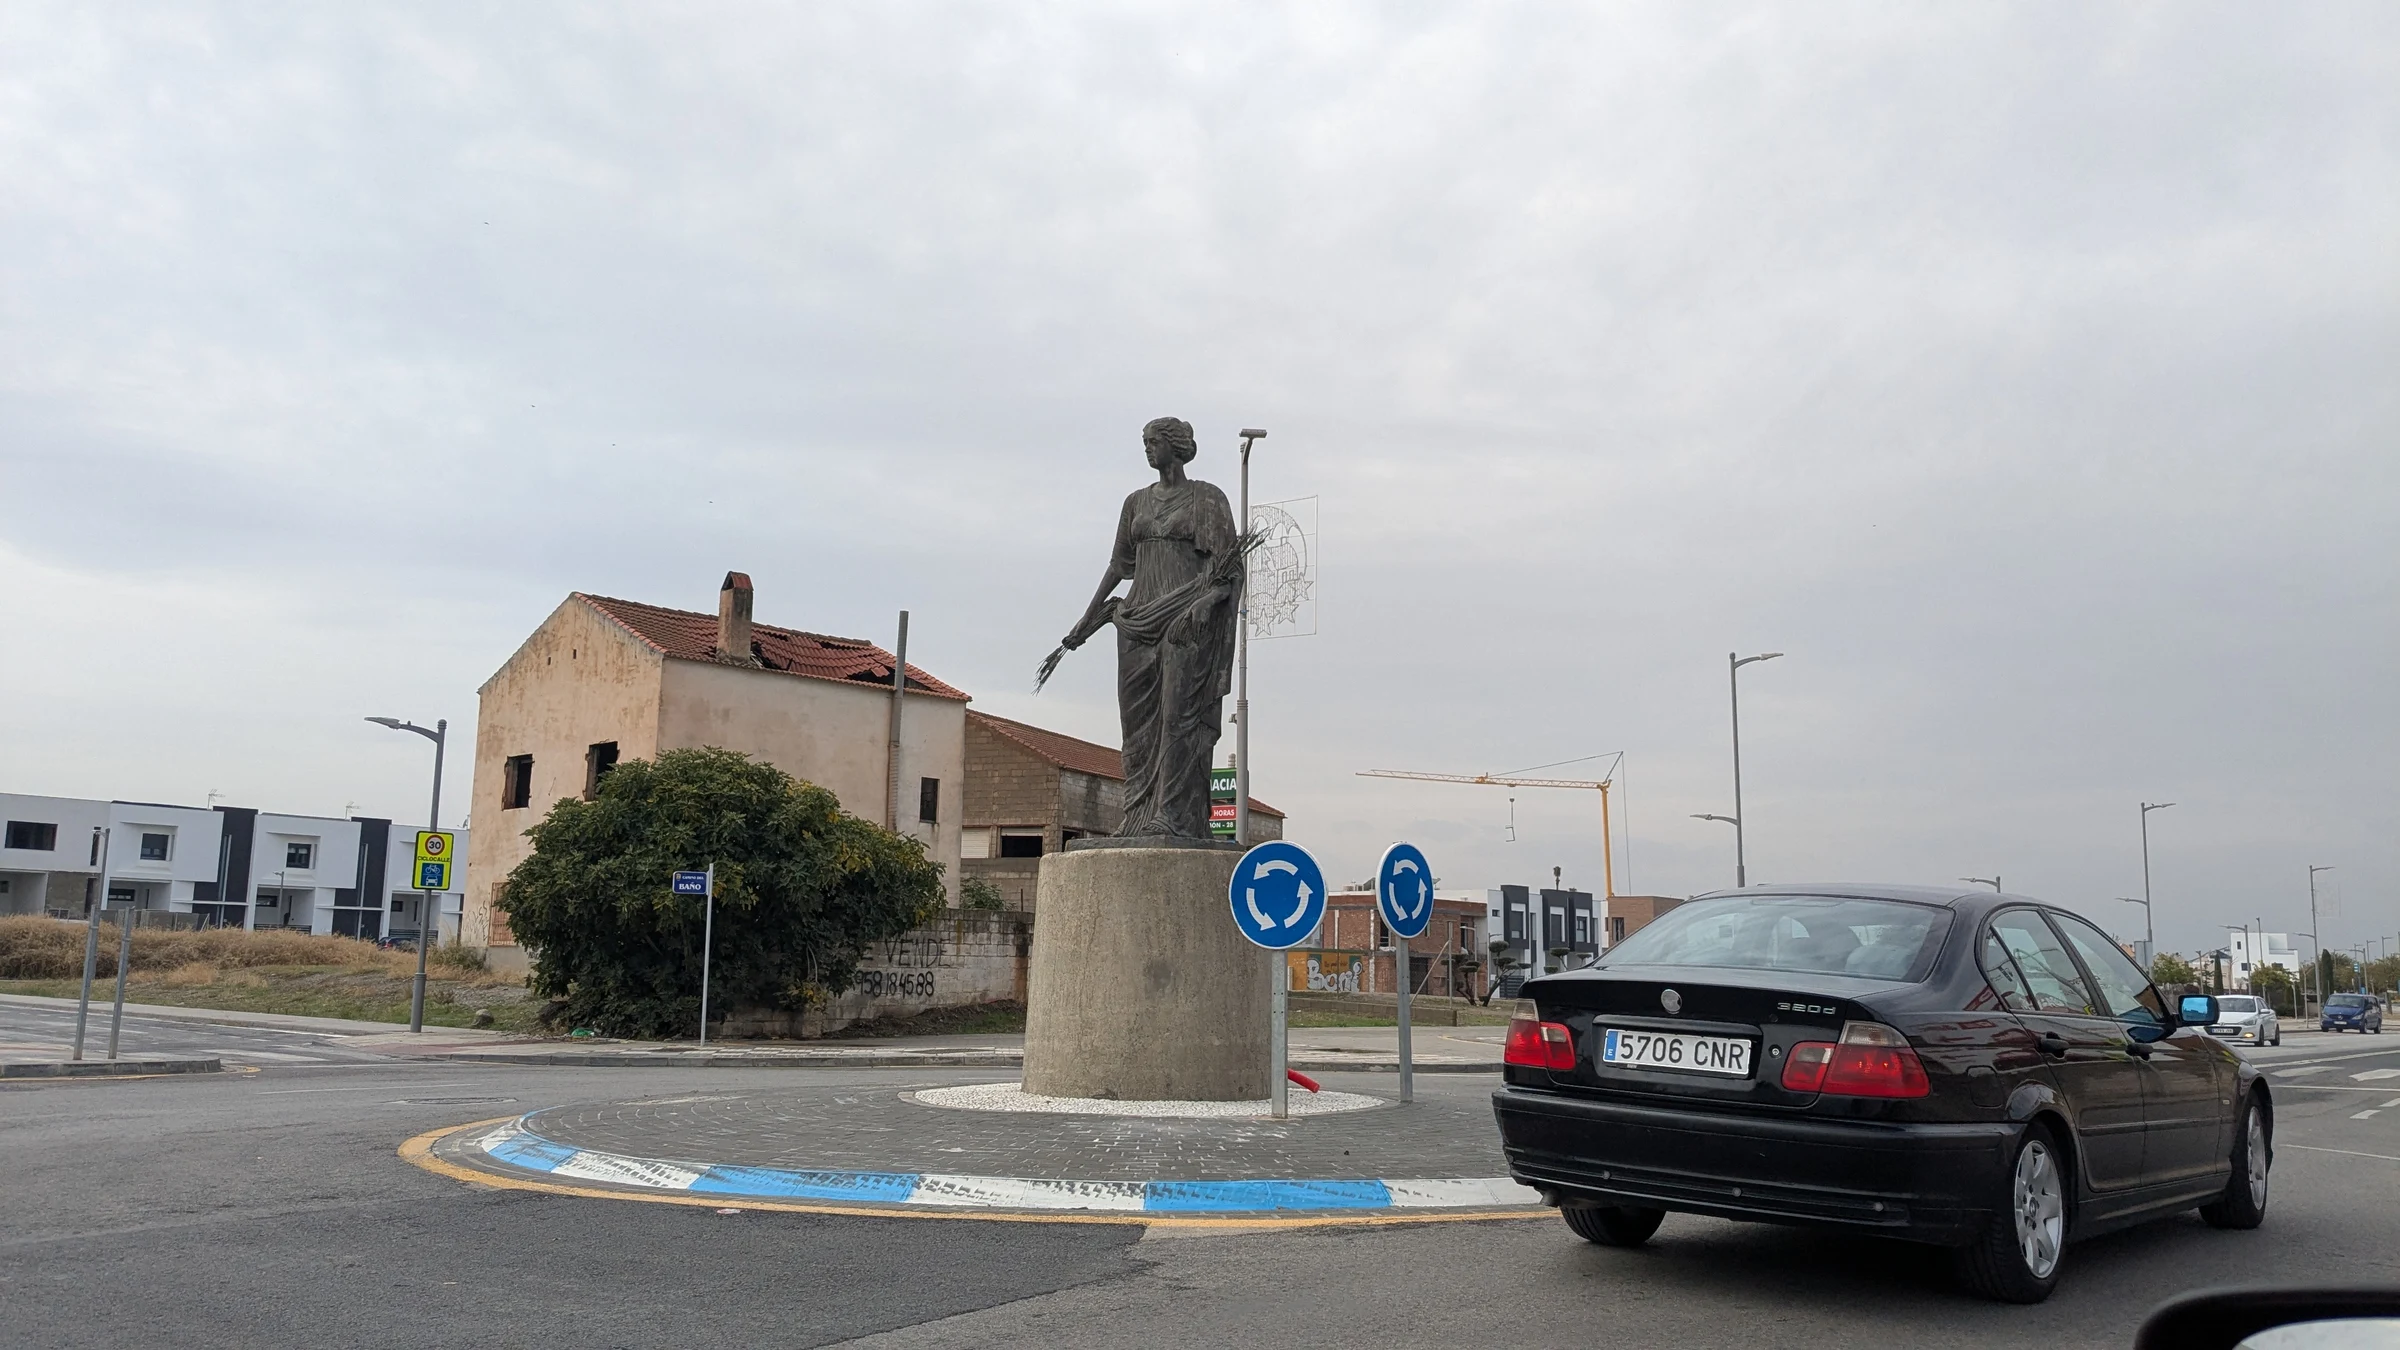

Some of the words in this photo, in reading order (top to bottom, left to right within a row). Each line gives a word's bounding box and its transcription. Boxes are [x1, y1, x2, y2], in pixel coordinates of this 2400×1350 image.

[1213, 809, 1235, 817] HORAS
[429, 840, 442, 850] 30
[417, 855, 450, 863] CICLOCALLE
[679, 881, 702, 891] BAÑO
[885, 938, 951, 968] VENDE
[1777, 1002, 1836, 1015] 320d
[1607, 1048, 1614, 1057] E
[1620, 1034, 1684, 1064] 5706
[1694, 1040, 1744, 1070] CNR
